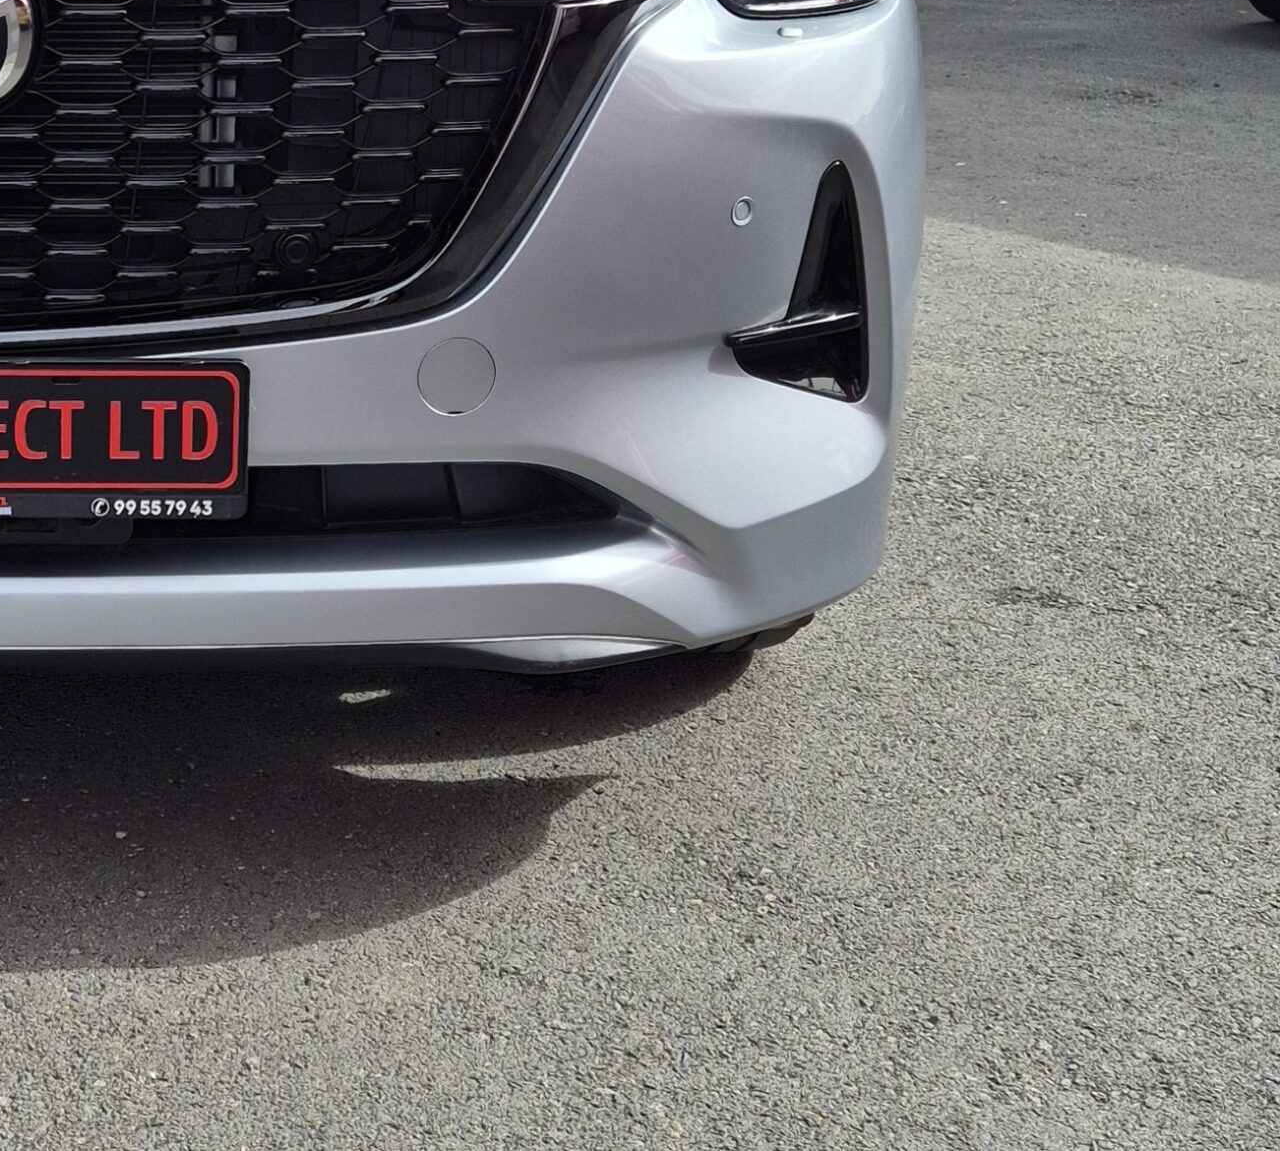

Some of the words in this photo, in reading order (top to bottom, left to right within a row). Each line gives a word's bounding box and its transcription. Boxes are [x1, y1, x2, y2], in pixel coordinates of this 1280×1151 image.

[109, 400, 219, 461] LTD
[113, 499, 137, 516] 99
[139, 499, 161, 516] 55
[164, 499, 187, 516] 79
[189, 499, 213, 518] 43
